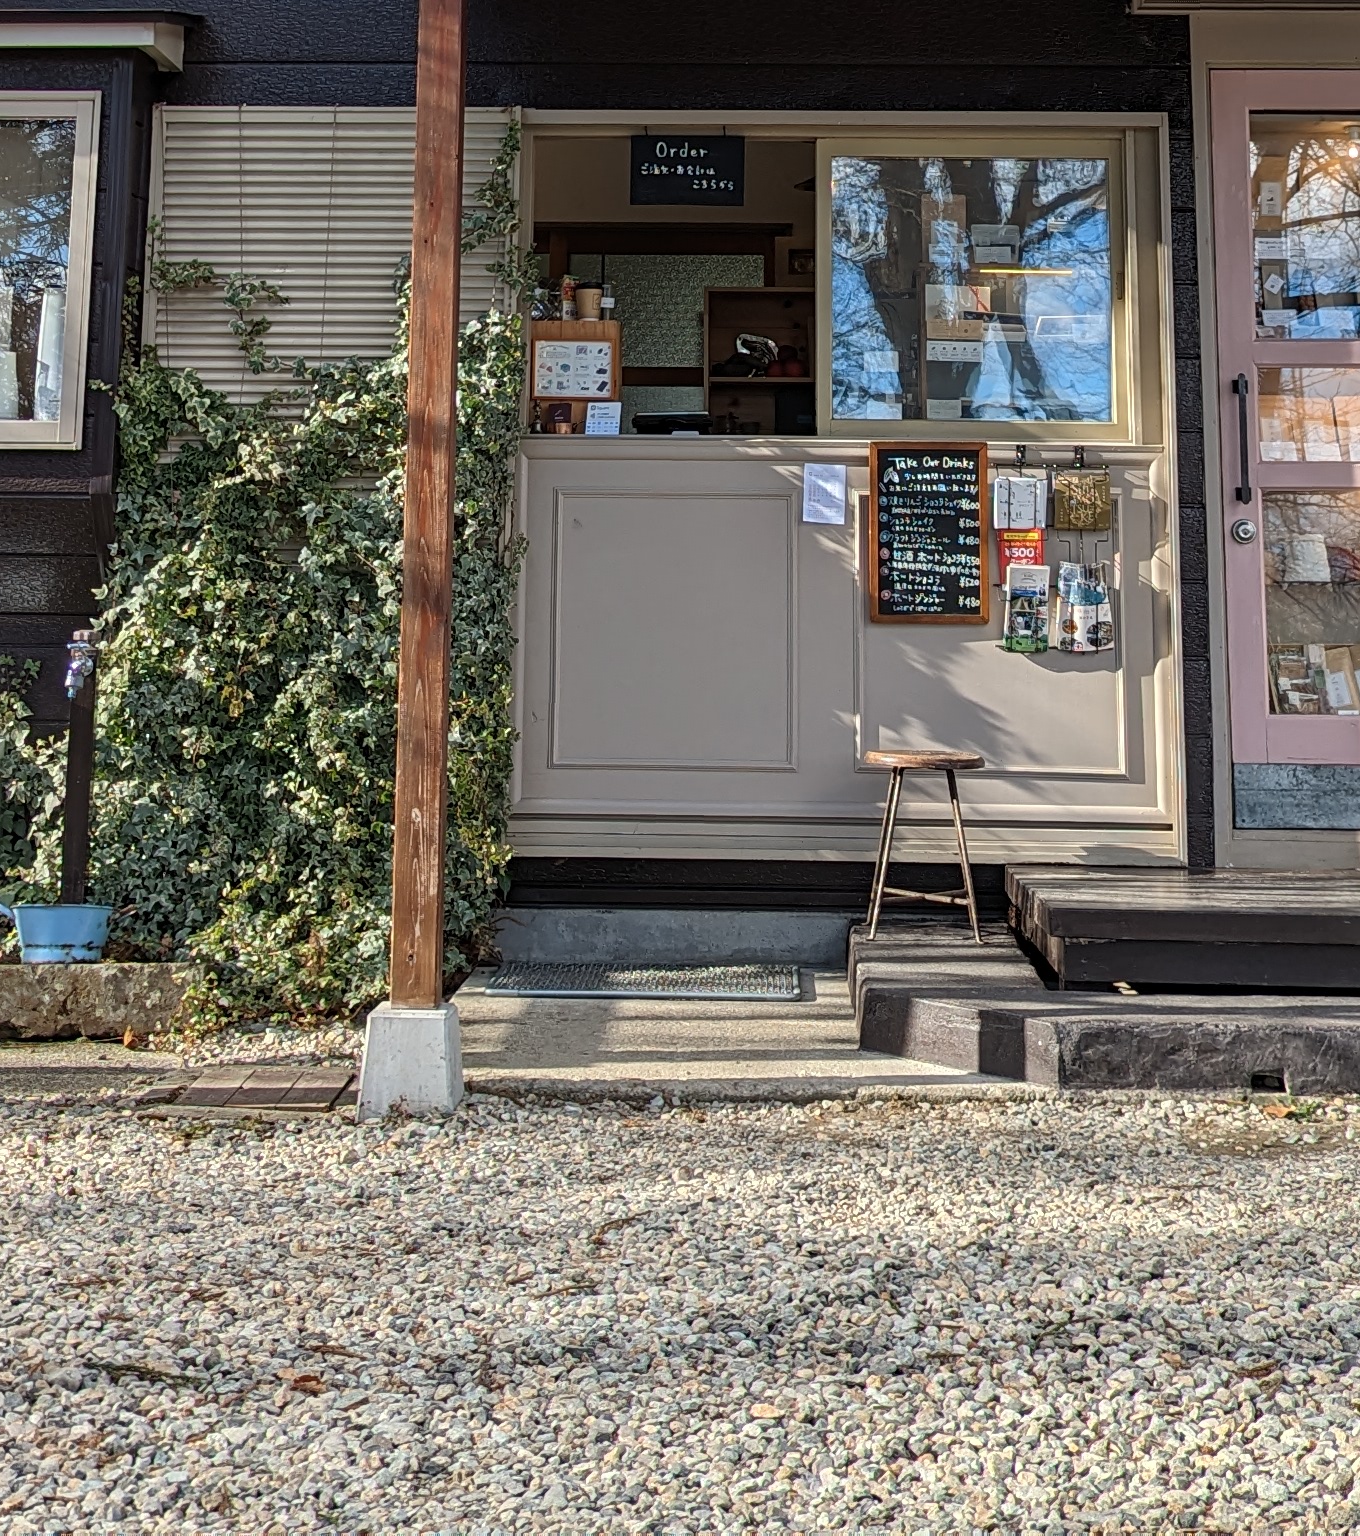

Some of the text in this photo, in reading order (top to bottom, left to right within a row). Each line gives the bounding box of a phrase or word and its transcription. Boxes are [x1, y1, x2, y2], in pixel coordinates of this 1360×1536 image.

[656, 141, 709, 158] Order
[692, 179, 734, 191] こちらから
[888, 457, 919, 470] Take
[942, 456, 975, 469] Drinks
[958, 517, 980, 529] ¥500
[893, 550, 914, 562] 甘酒
